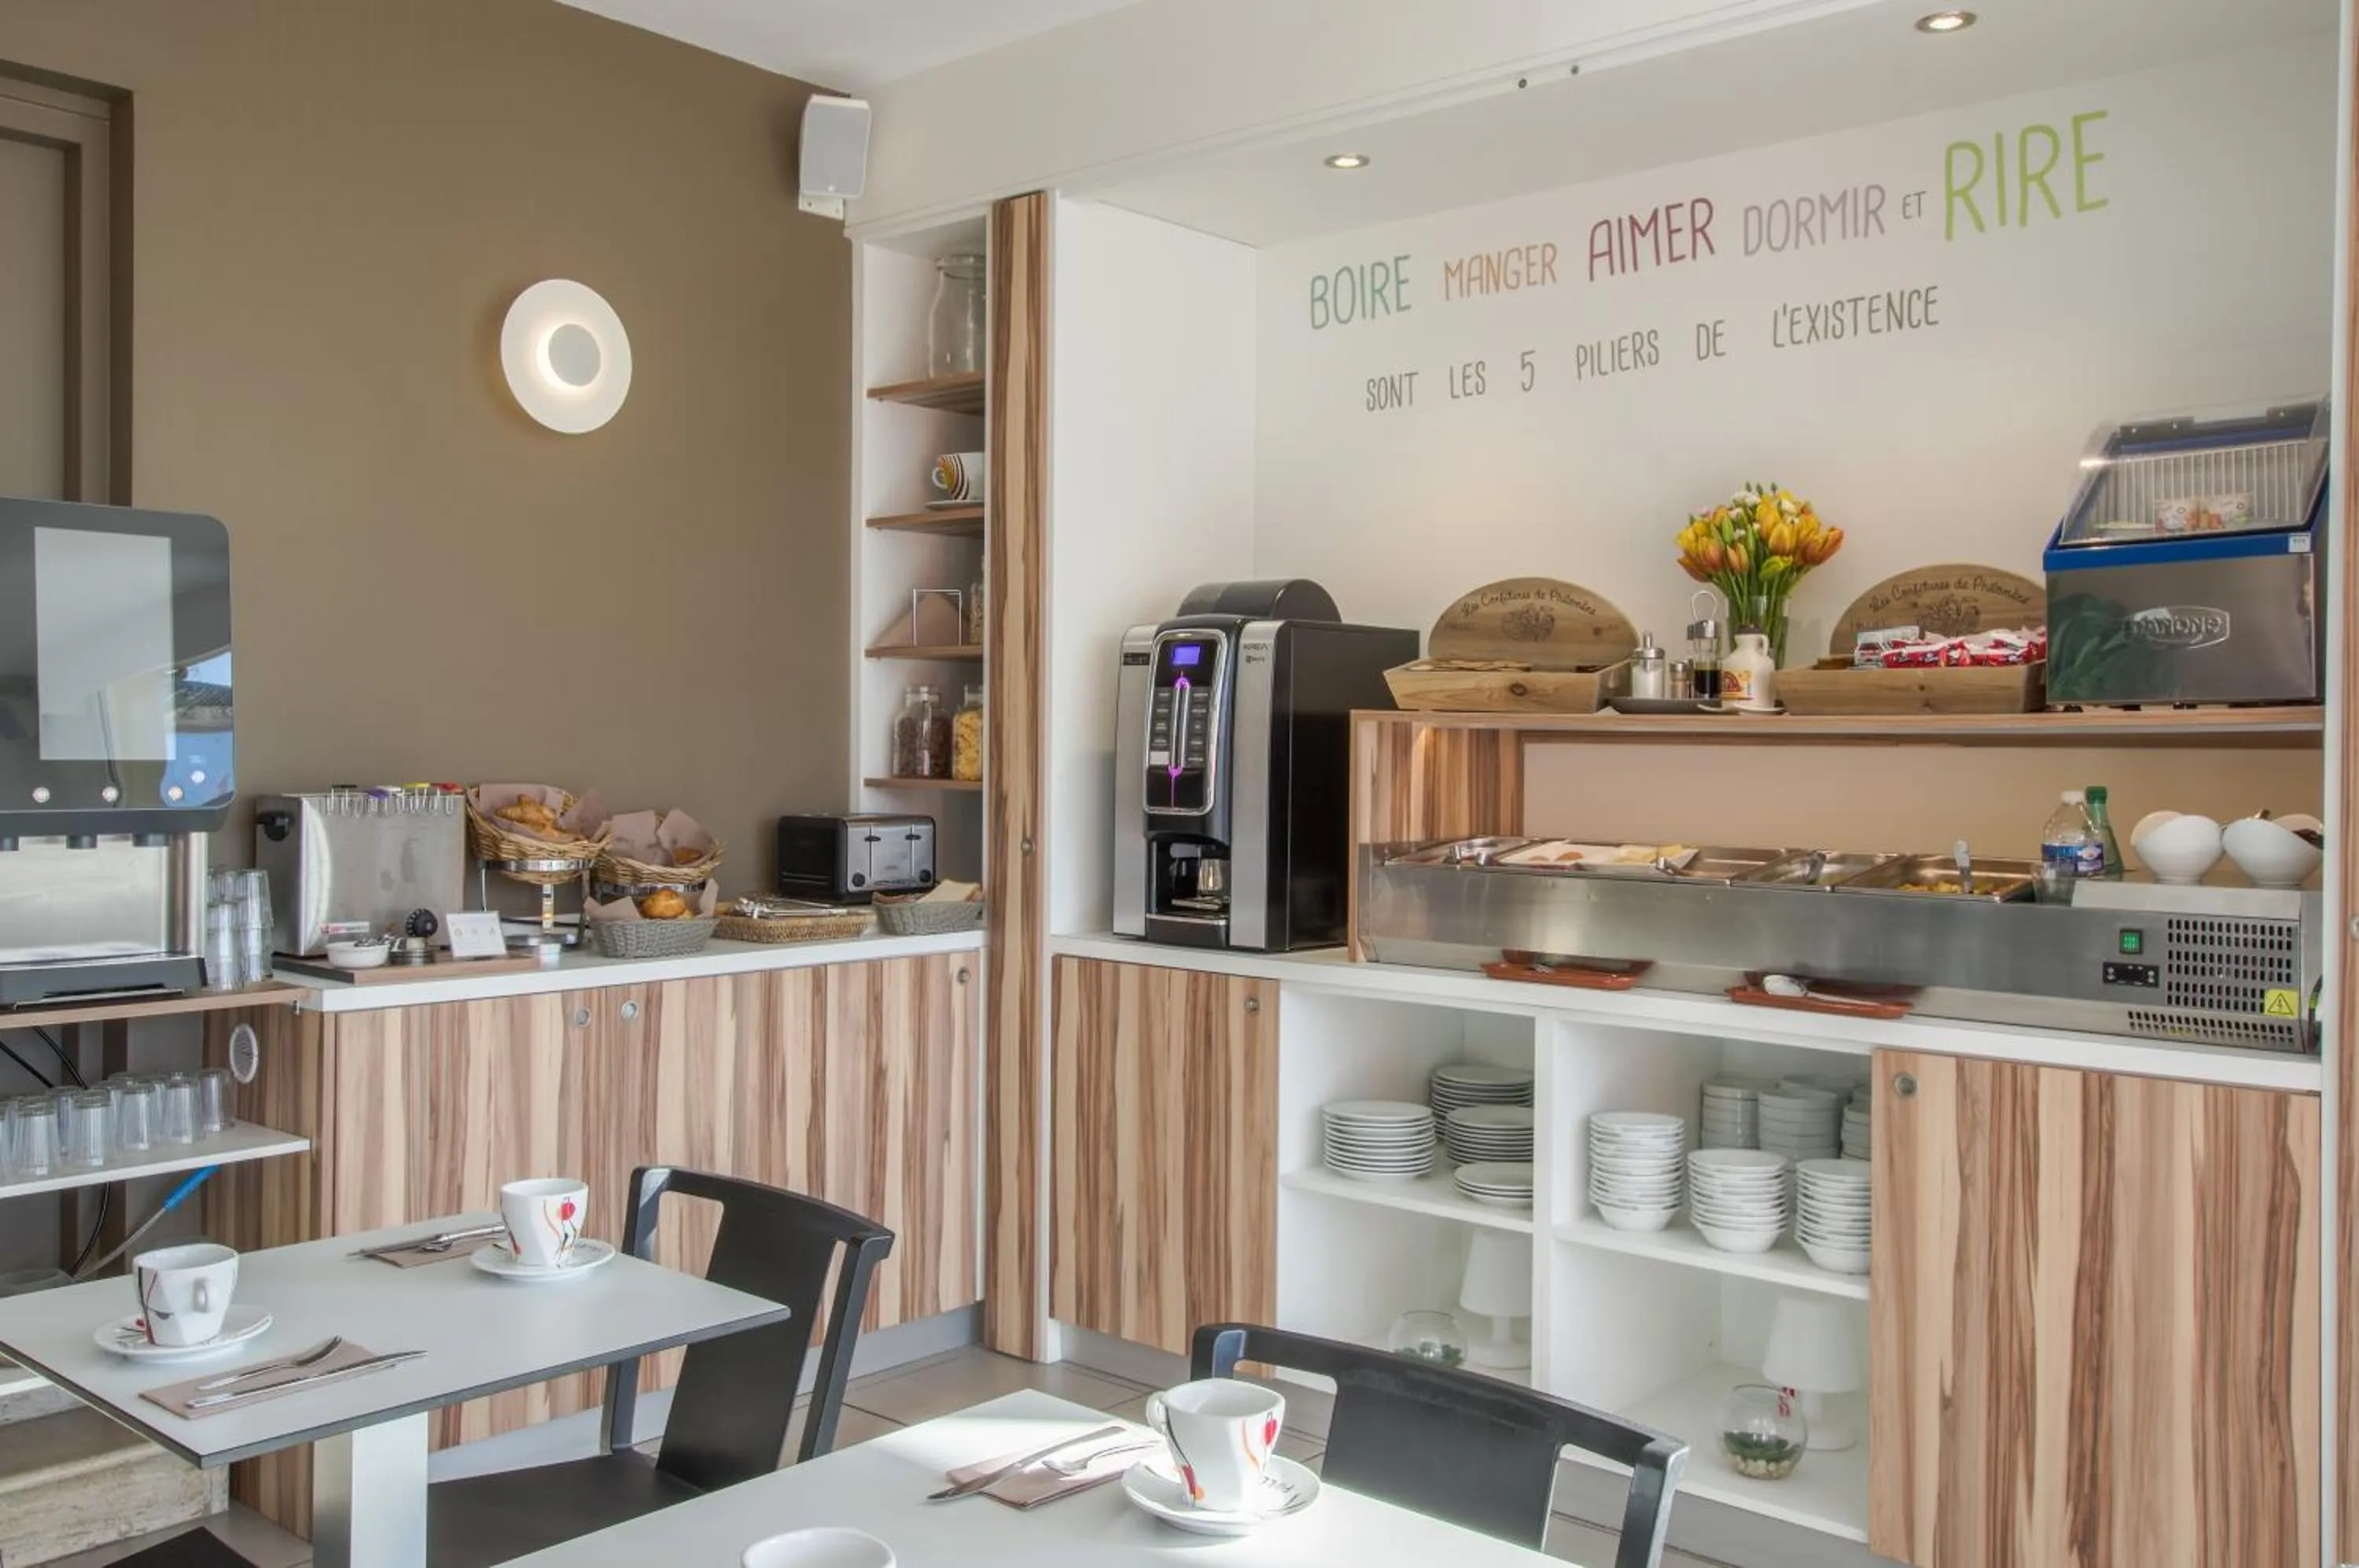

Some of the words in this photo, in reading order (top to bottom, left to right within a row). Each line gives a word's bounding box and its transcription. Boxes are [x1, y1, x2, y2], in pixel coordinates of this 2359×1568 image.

[1310, 254, 1412, 330] BOIRE
[1443, 241, 1558, 301] MANGER
[1588, 197, 1716, 282] AIMER
[1743, 184, 1886, 256] DORMIR
[1901, 190, 1927, 220] ET
[1944, 109, 2109, 242] RIRE
[1366, 371, 1419, 412] SONT
[1449, 360, 1486, 399] LES
[1520, 349, 1536, 392] 5
[1575, 329, 1660, 381] PILIERS
[1695, 318, 1726, 362] DE
[1772, 285, 1939, 348] L'EXISTENCE
[1481, 592, 1531, 607] Confitures
[1892, 580, 1950, 599] Confitures
[1954, 578, 1968, 590] de
